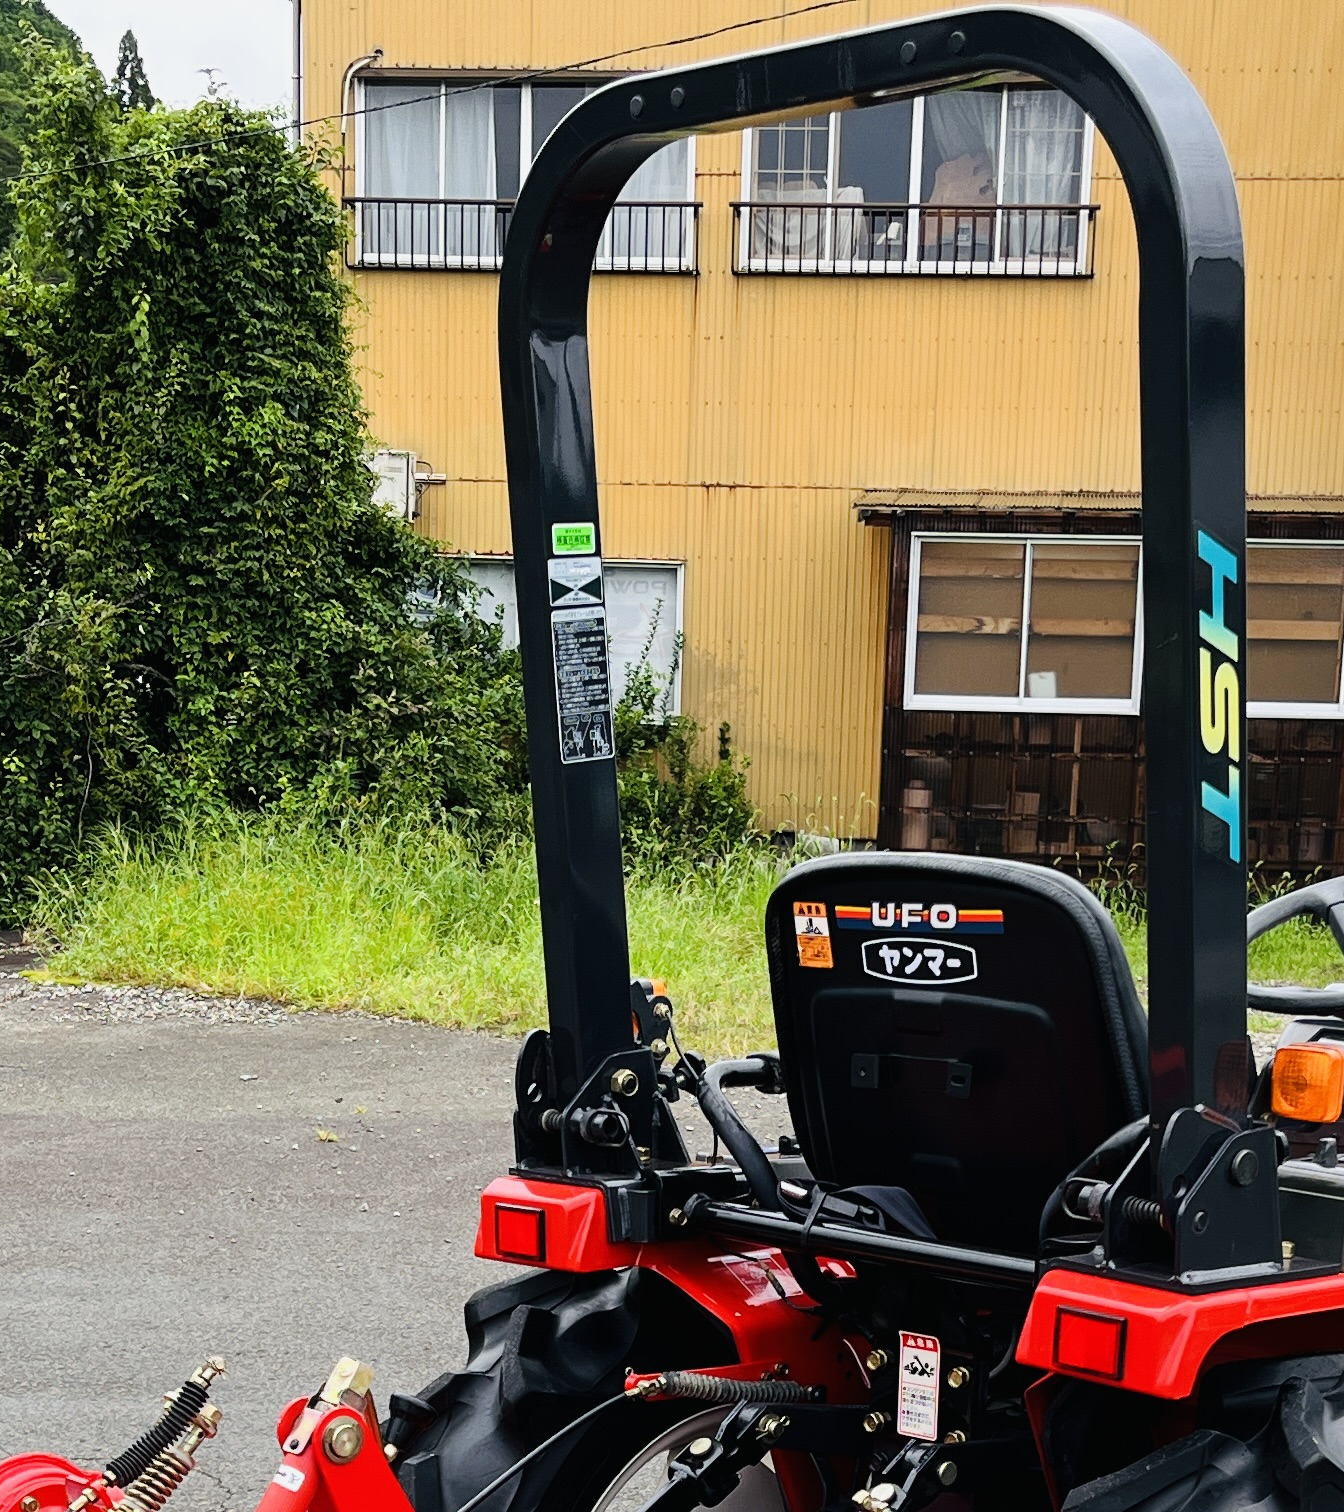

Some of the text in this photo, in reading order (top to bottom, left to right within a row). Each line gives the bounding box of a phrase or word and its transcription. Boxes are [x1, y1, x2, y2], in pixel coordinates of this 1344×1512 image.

[1197, 529, 1240, 863] HST
[870, 901, 958, 930] UFO
[878, 944, 962, 977] ヤンマー
